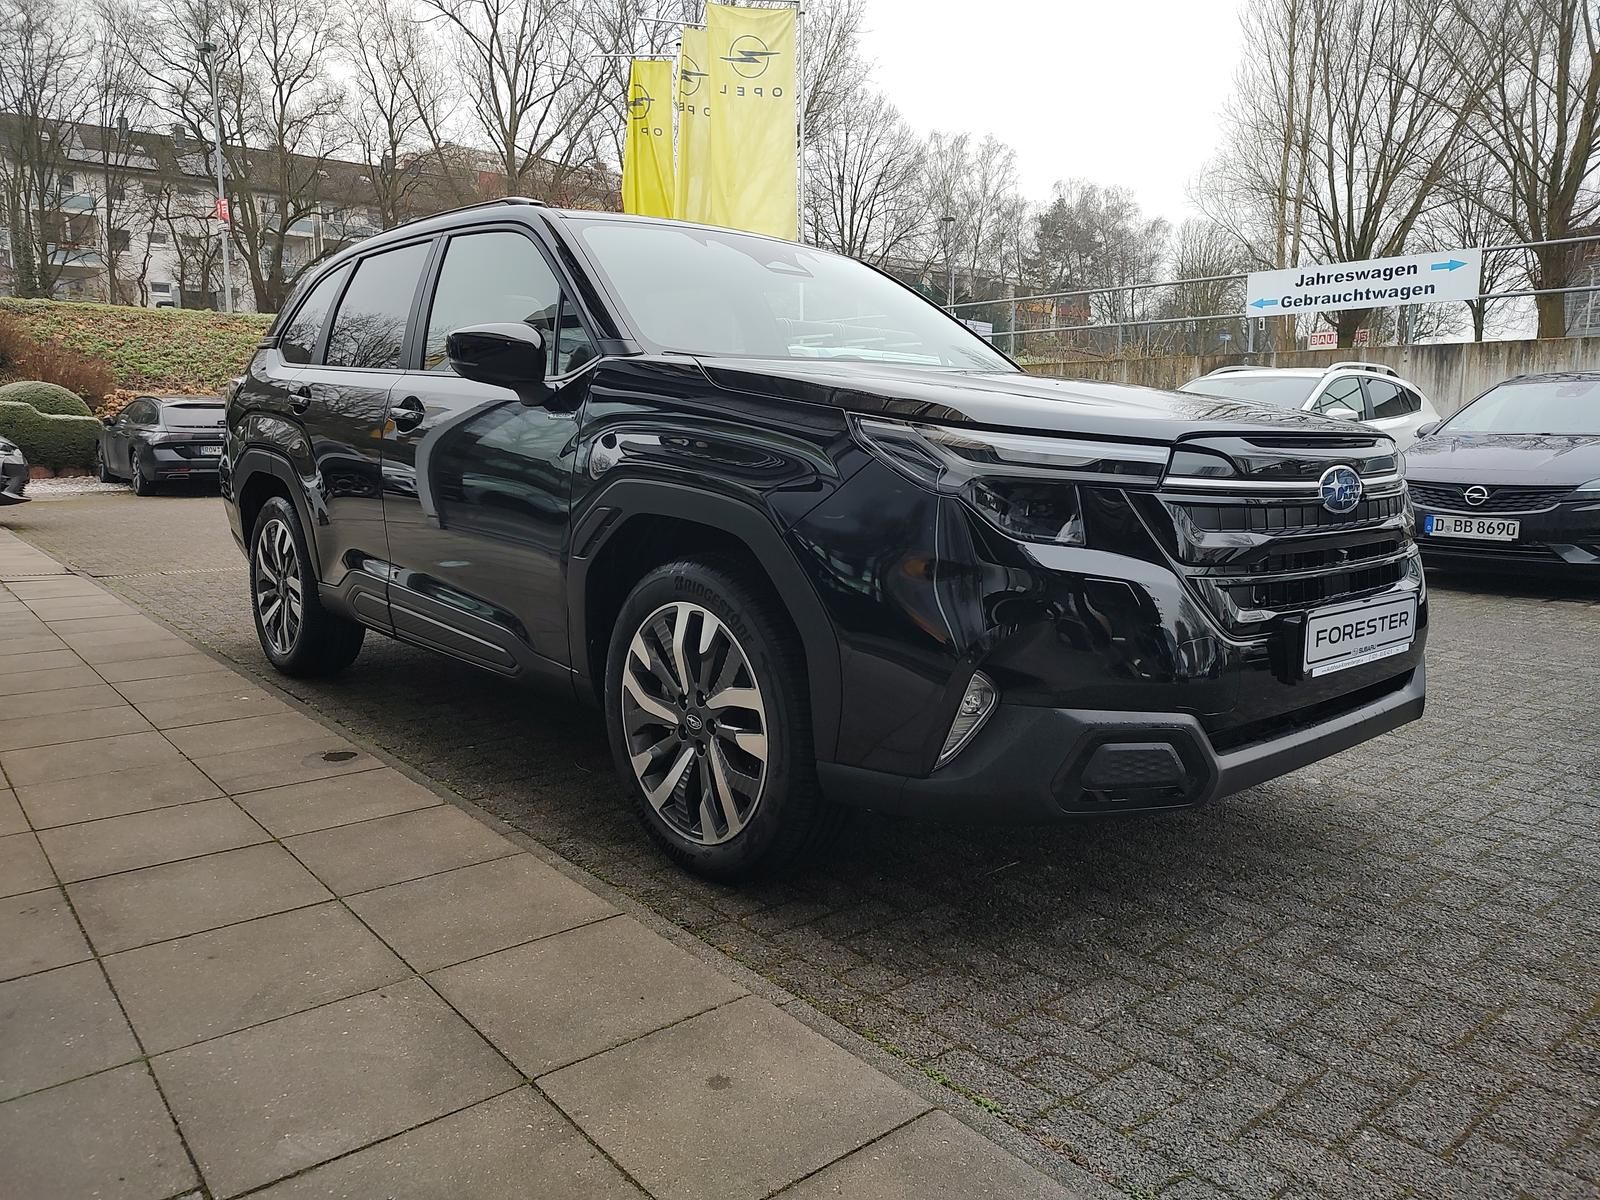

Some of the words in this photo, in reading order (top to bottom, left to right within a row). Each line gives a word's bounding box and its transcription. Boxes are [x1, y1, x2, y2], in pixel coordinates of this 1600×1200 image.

[1295, 263, 1418, 288] Jahreswagen
[1280, 283, 1436, 309] Gebrauchtwagen
[1435, 518, 1445, 531] D
[1453, 519, 1473, 533] BB
[1476, 521, 1516, 536] 8690
[673, 575, 755, 643] BRIDGESTONE
[1315, 611, 1409, 648] FORESTER
[1358, 644, 1377, 654] SUBARU
